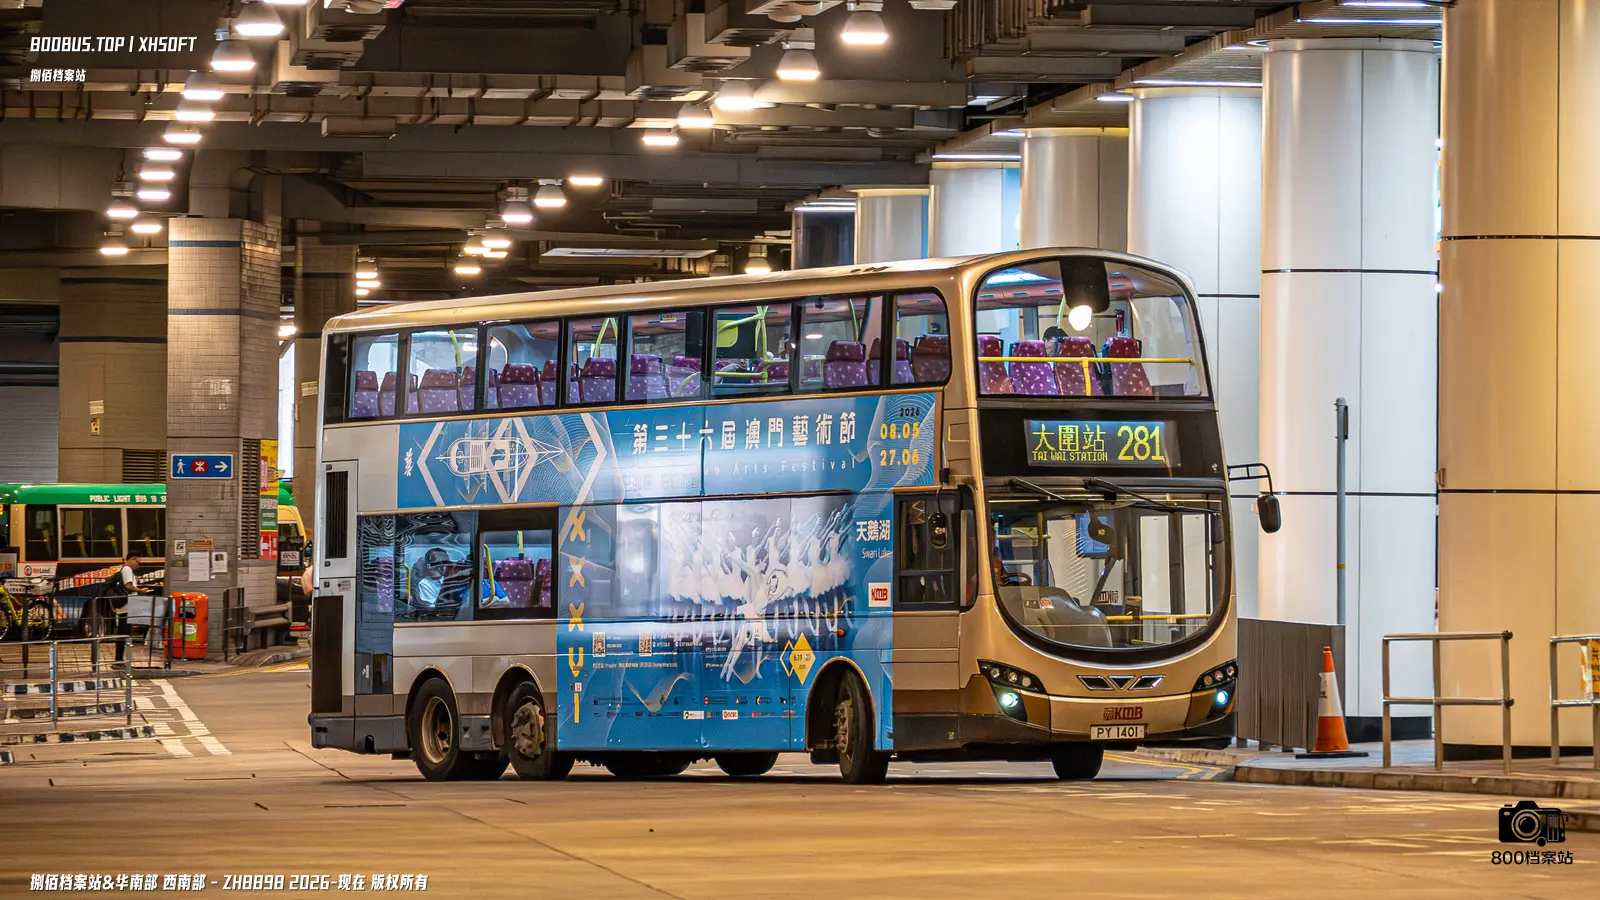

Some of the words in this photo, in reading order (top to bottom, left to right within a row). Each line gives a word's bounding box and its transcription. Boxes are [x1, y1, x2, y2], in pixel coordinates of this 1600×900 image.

[900, 407, 920, 417] 2026
[880, 422, 920, 440] 08.05
[1032, 424, 1107, 452] 大圍站
[1117, 425, 1165, 461] 281
[880, 449, 919, 466] 27.06
[1032, 451, 1048, 461] TAI
[1050, 451, 1067, 461] WAI
[1069, 451, 1108, 461] STATION
[733, 462, 768, 475] Arts
[781, 457, 855, 472] Festival
[856, 520, 891, 542] 天鵝湖
[861, 548, 877, 559] Swan
[871, 588, 888, 601] KMB
[1114, 706, 1143, 720] KMB
[1097, 727, 1112, 738] PY
[1116, 726, 1138, 738] 1401
